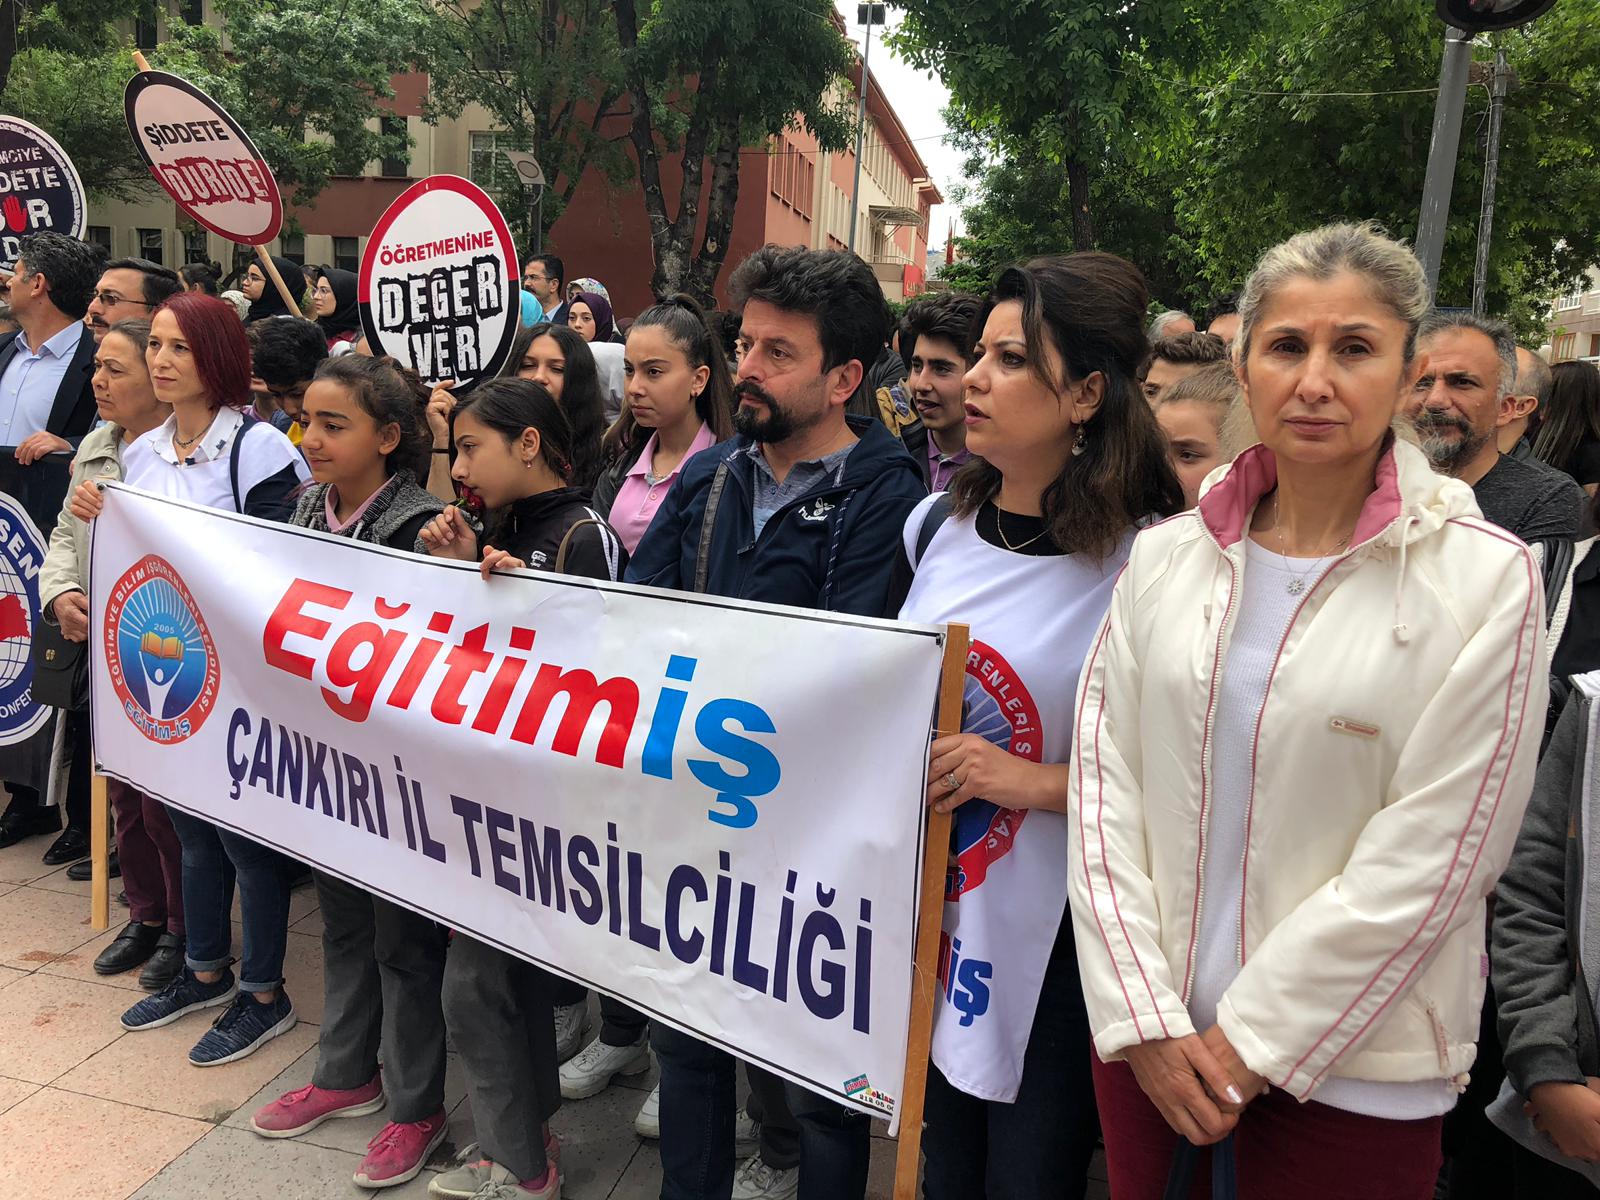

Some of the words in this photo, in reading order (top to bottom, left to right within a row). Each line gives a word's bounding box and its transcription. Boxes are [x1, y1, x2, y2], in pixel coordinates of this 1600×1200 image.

[143, 119, 230, 152] ŞİDDETE
[0, 146, 43, 164] MCİYE
[0, 165, 61, 193] DETE
[380, 230, 495, 266] ÖĞRETMENİNE
[381, 262, 499, 328] DEĞER
[412, 325, 478, 377] VER
[0, 518, 40, 581] SEN
[108, 603, 120, 623] VE
[153, 622, 175, 634] 2005
[967, 650, 1035, 735] RENLERİ
[226, 707, 390, 840] ÇANKIRI
[393, 754, 447, 864] İL
[449, 793, 873, 1035] TEMSİLCİLİĞİ
